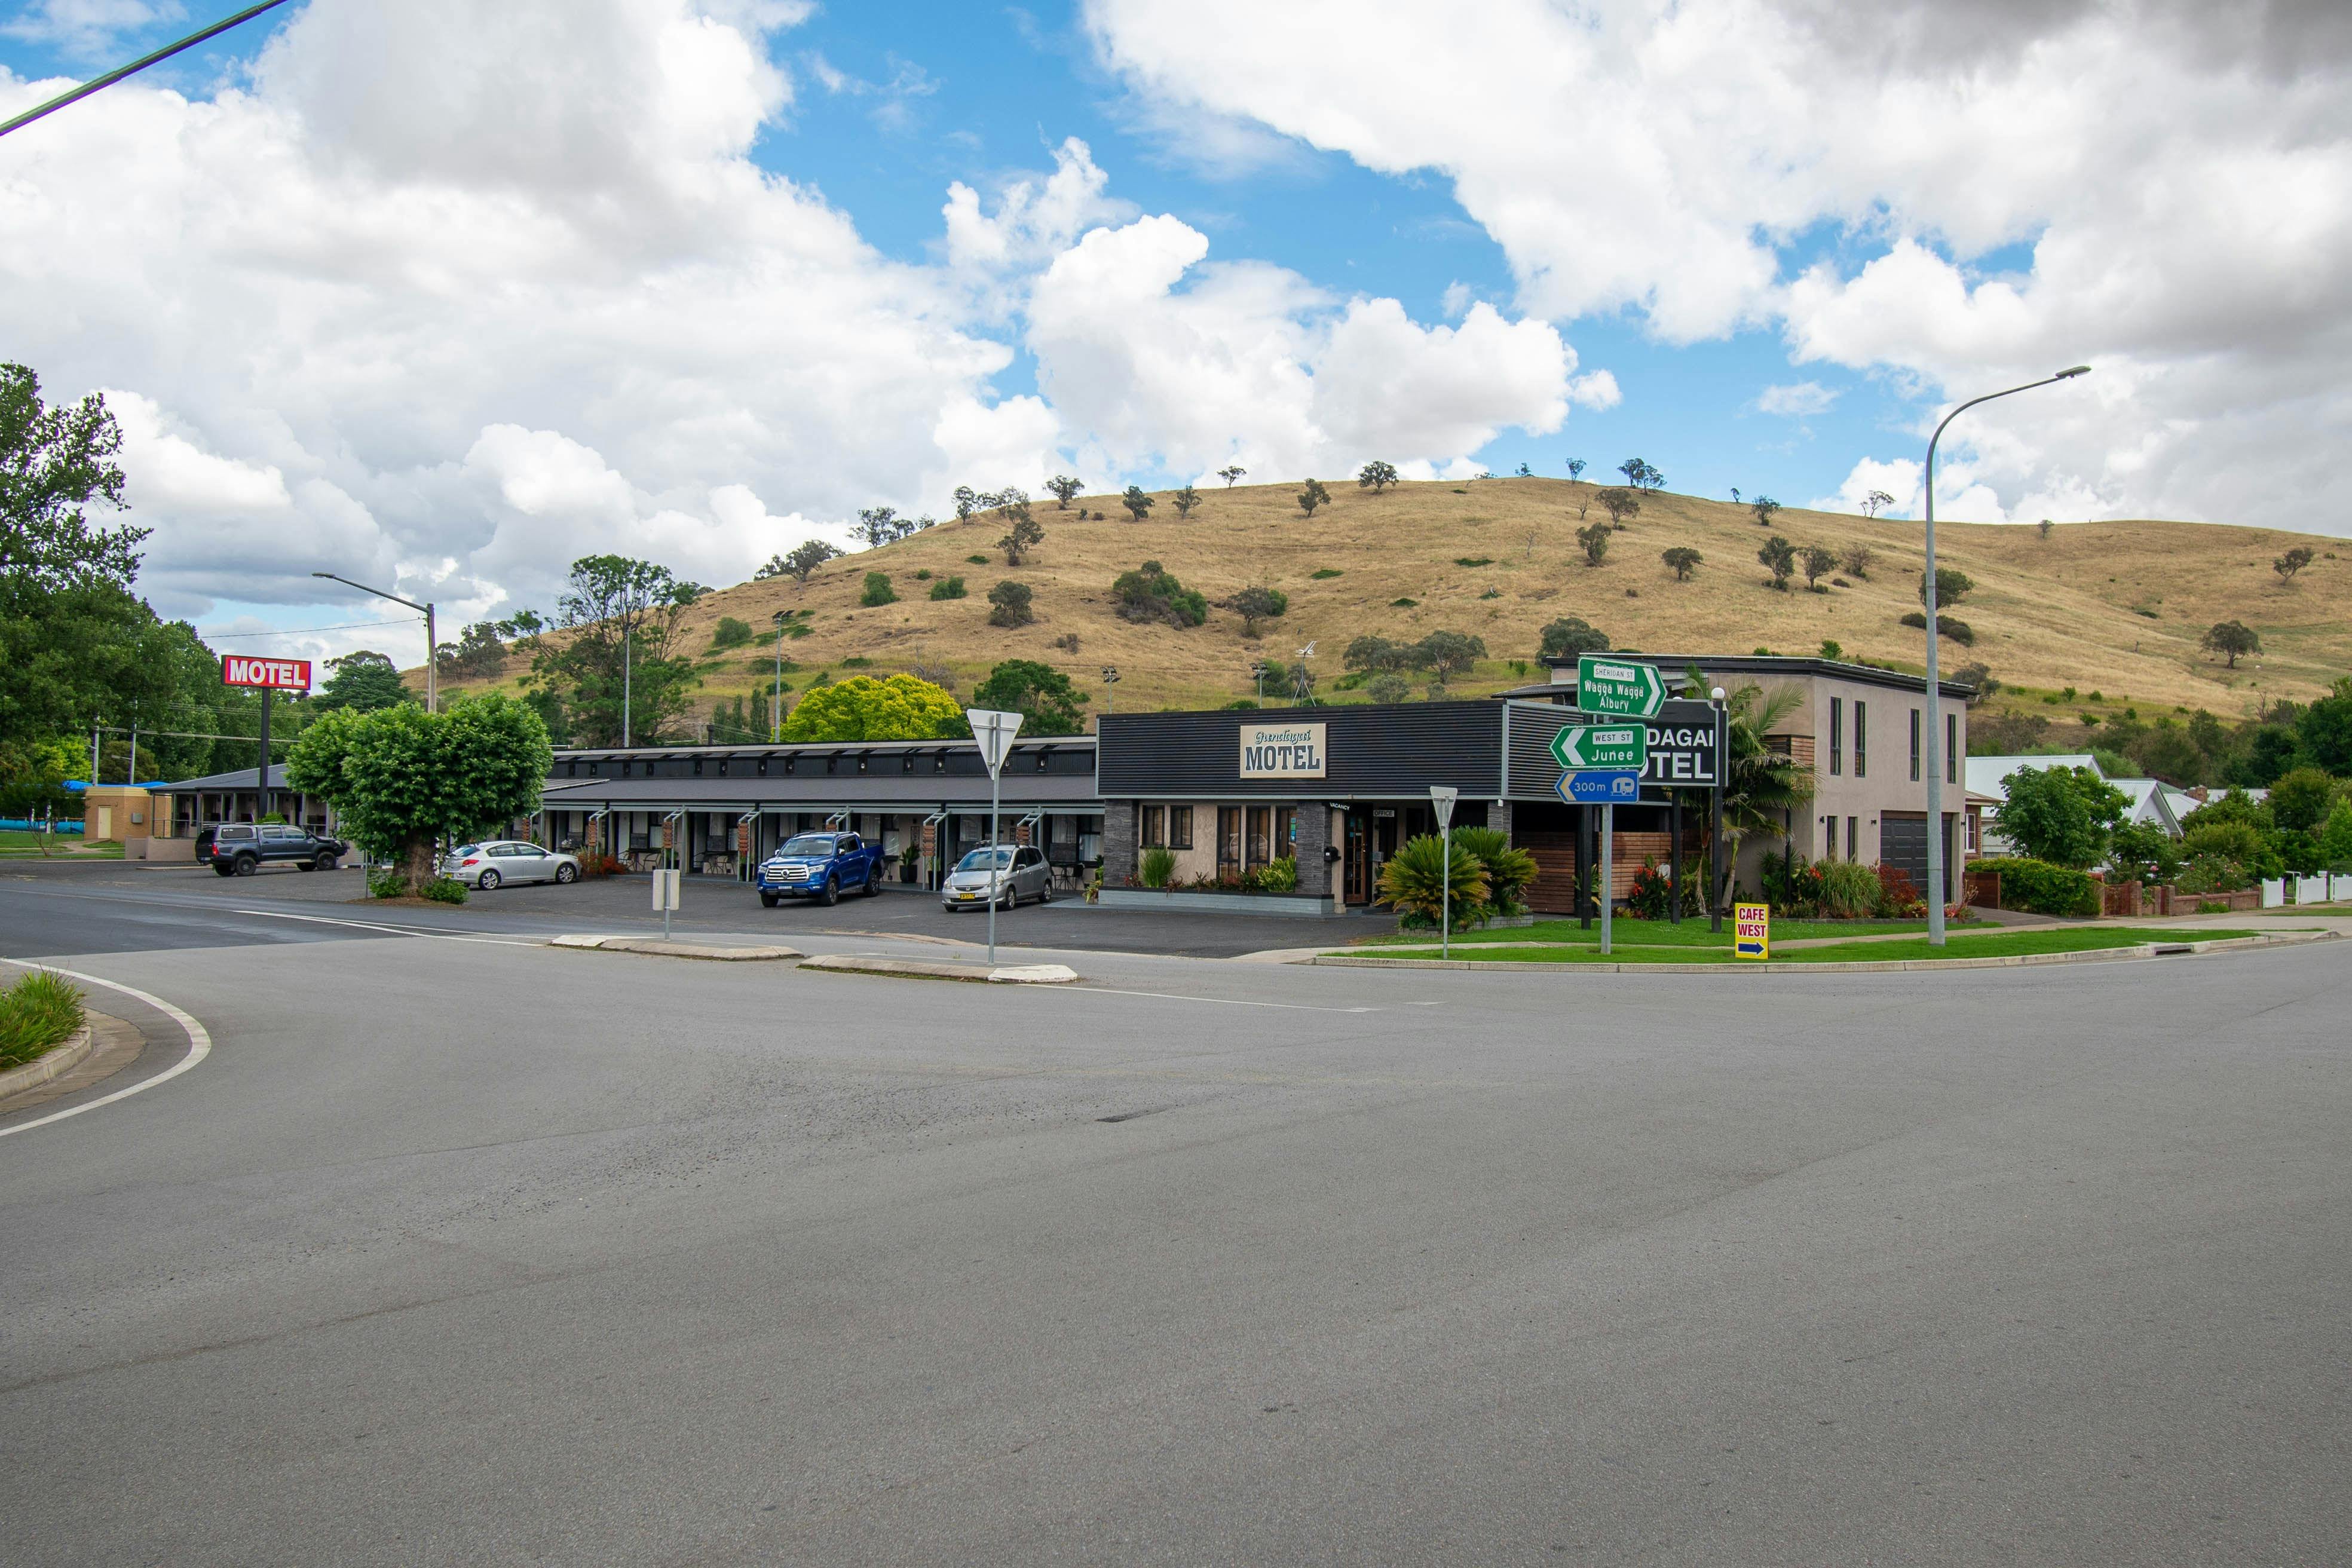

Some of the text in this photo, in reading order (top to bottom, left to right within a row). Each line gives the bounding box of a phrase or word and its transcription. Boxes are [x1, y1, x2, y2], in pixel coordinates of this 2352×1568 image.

[230, 659, 306, 686] MOTEL
[1595, 668, 1624, 678] SHERIDAN
[1584, 680, 1644, 700] Wagga Wagga
[1600, 696, 1629, 713] Albury
[1255, 730, 1311, 745] Gundagai
[1646, 728, 1713, 747] DAGAI
[1245, 745, 1320, 771] MOTEL
[1591, 749, 1634, 761] Junee
[1639, 752, 1713, 779] TEL
[1330, 803, 1350, 811] VACANCY
[1739, 908, 1765, 921] CAFE
[1738, 924, 1766, 937] WEST
